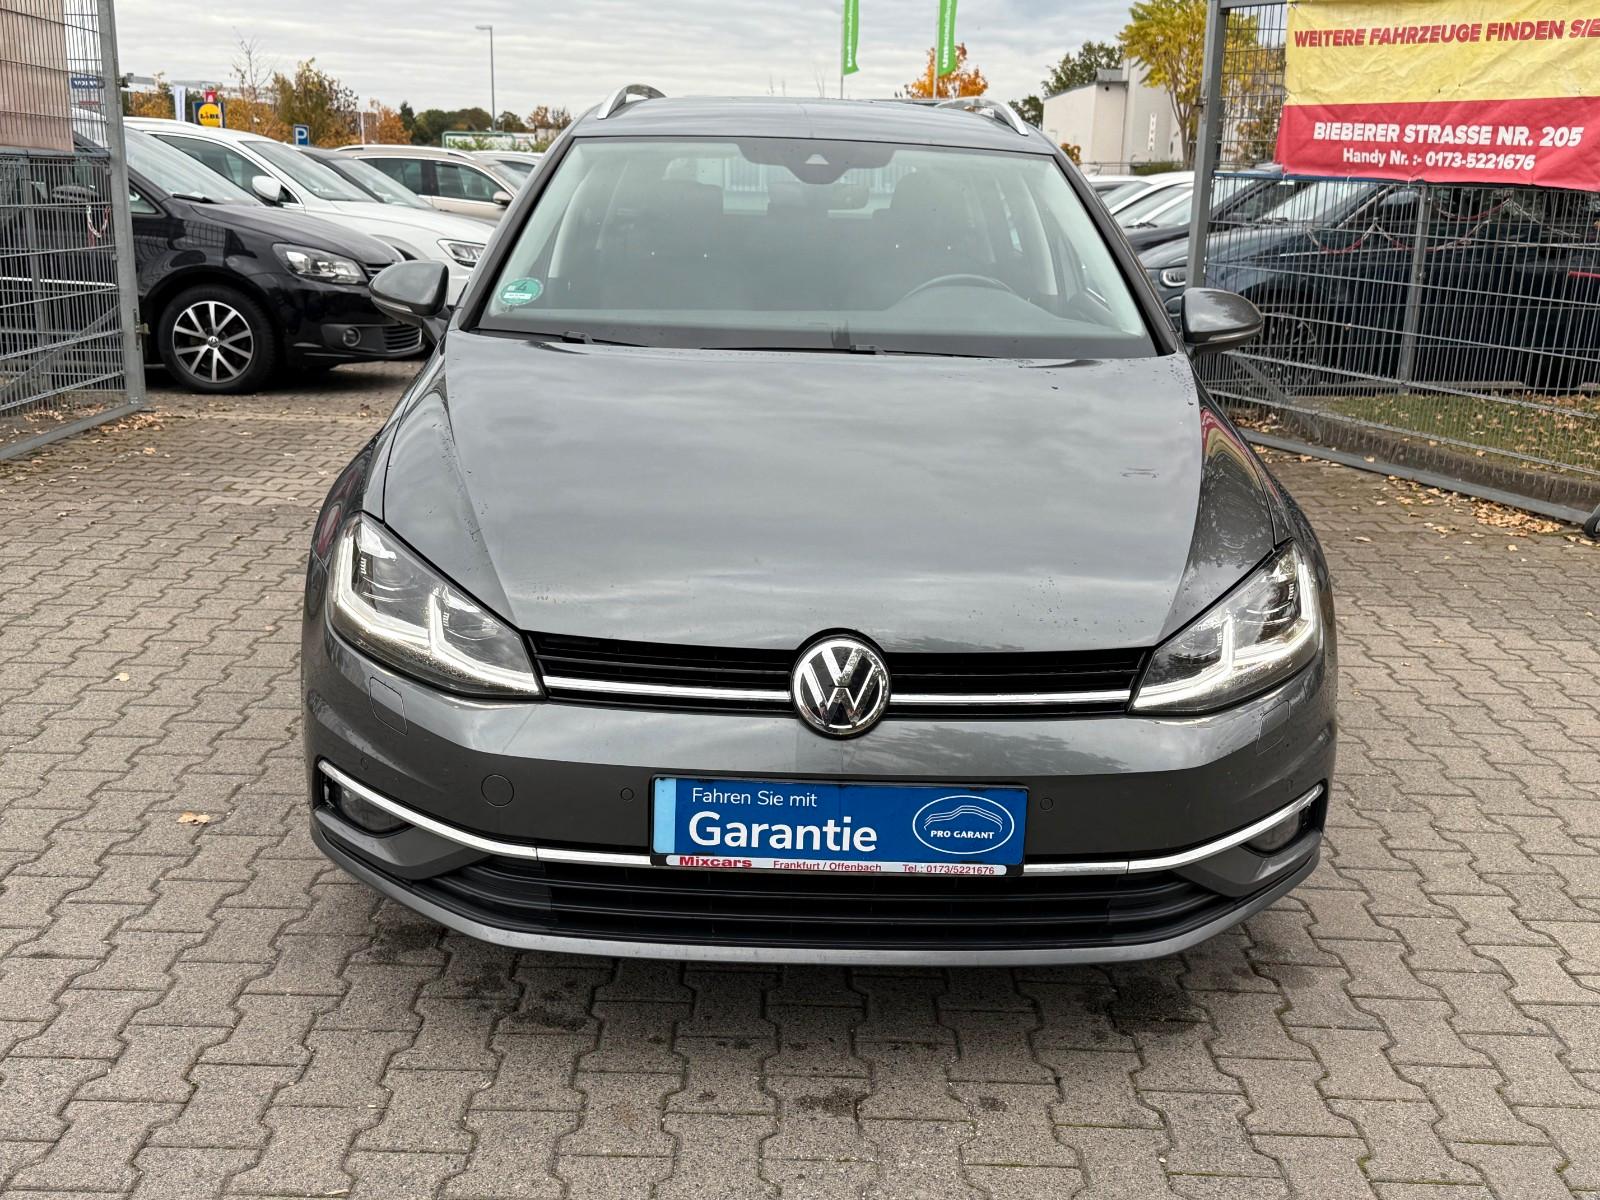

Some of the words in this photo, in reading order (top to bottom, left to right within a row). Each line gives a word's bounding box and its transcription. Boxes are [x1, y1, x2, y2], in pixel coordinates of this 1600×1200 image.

[1294, 29, 1366, 48] WEITERE
[1369, 23, 1482, 46] FAHRZEUGE
[1486, 20, 1565, 42] FINDEN
[1569, 18, 1600, 38] SIE
[295, 127, 307, 146] P
[1313, 122, 1400, 143] BIEBERER
[1403, 124, 1493, 145] STRASSE
[1496, 125, 1534, 147] NR.
[1539, 126, 1584, 148] 205
[1343, 147, 1386, 167] Handy
[1389, 149, 1409, 165] Nr.
[1425, 151, 1536, 170] 0173-5221676
[692, 788, 751, 804] Fahren
[757, 790, 784, 806] Sie
[789, 793, 818, 808] mit
[688, 811, 878, 852] Garantie
[930, 830, 951, 838] PRO
[953, 831, 995, 839] GARANT
[679, 856, 752, 868] Mixcars
[773, 860, 820, 870] Frankfurt
[829, 863, 882, 872] Offenbach
[926, 864, 995, 875] 0173/5221676
